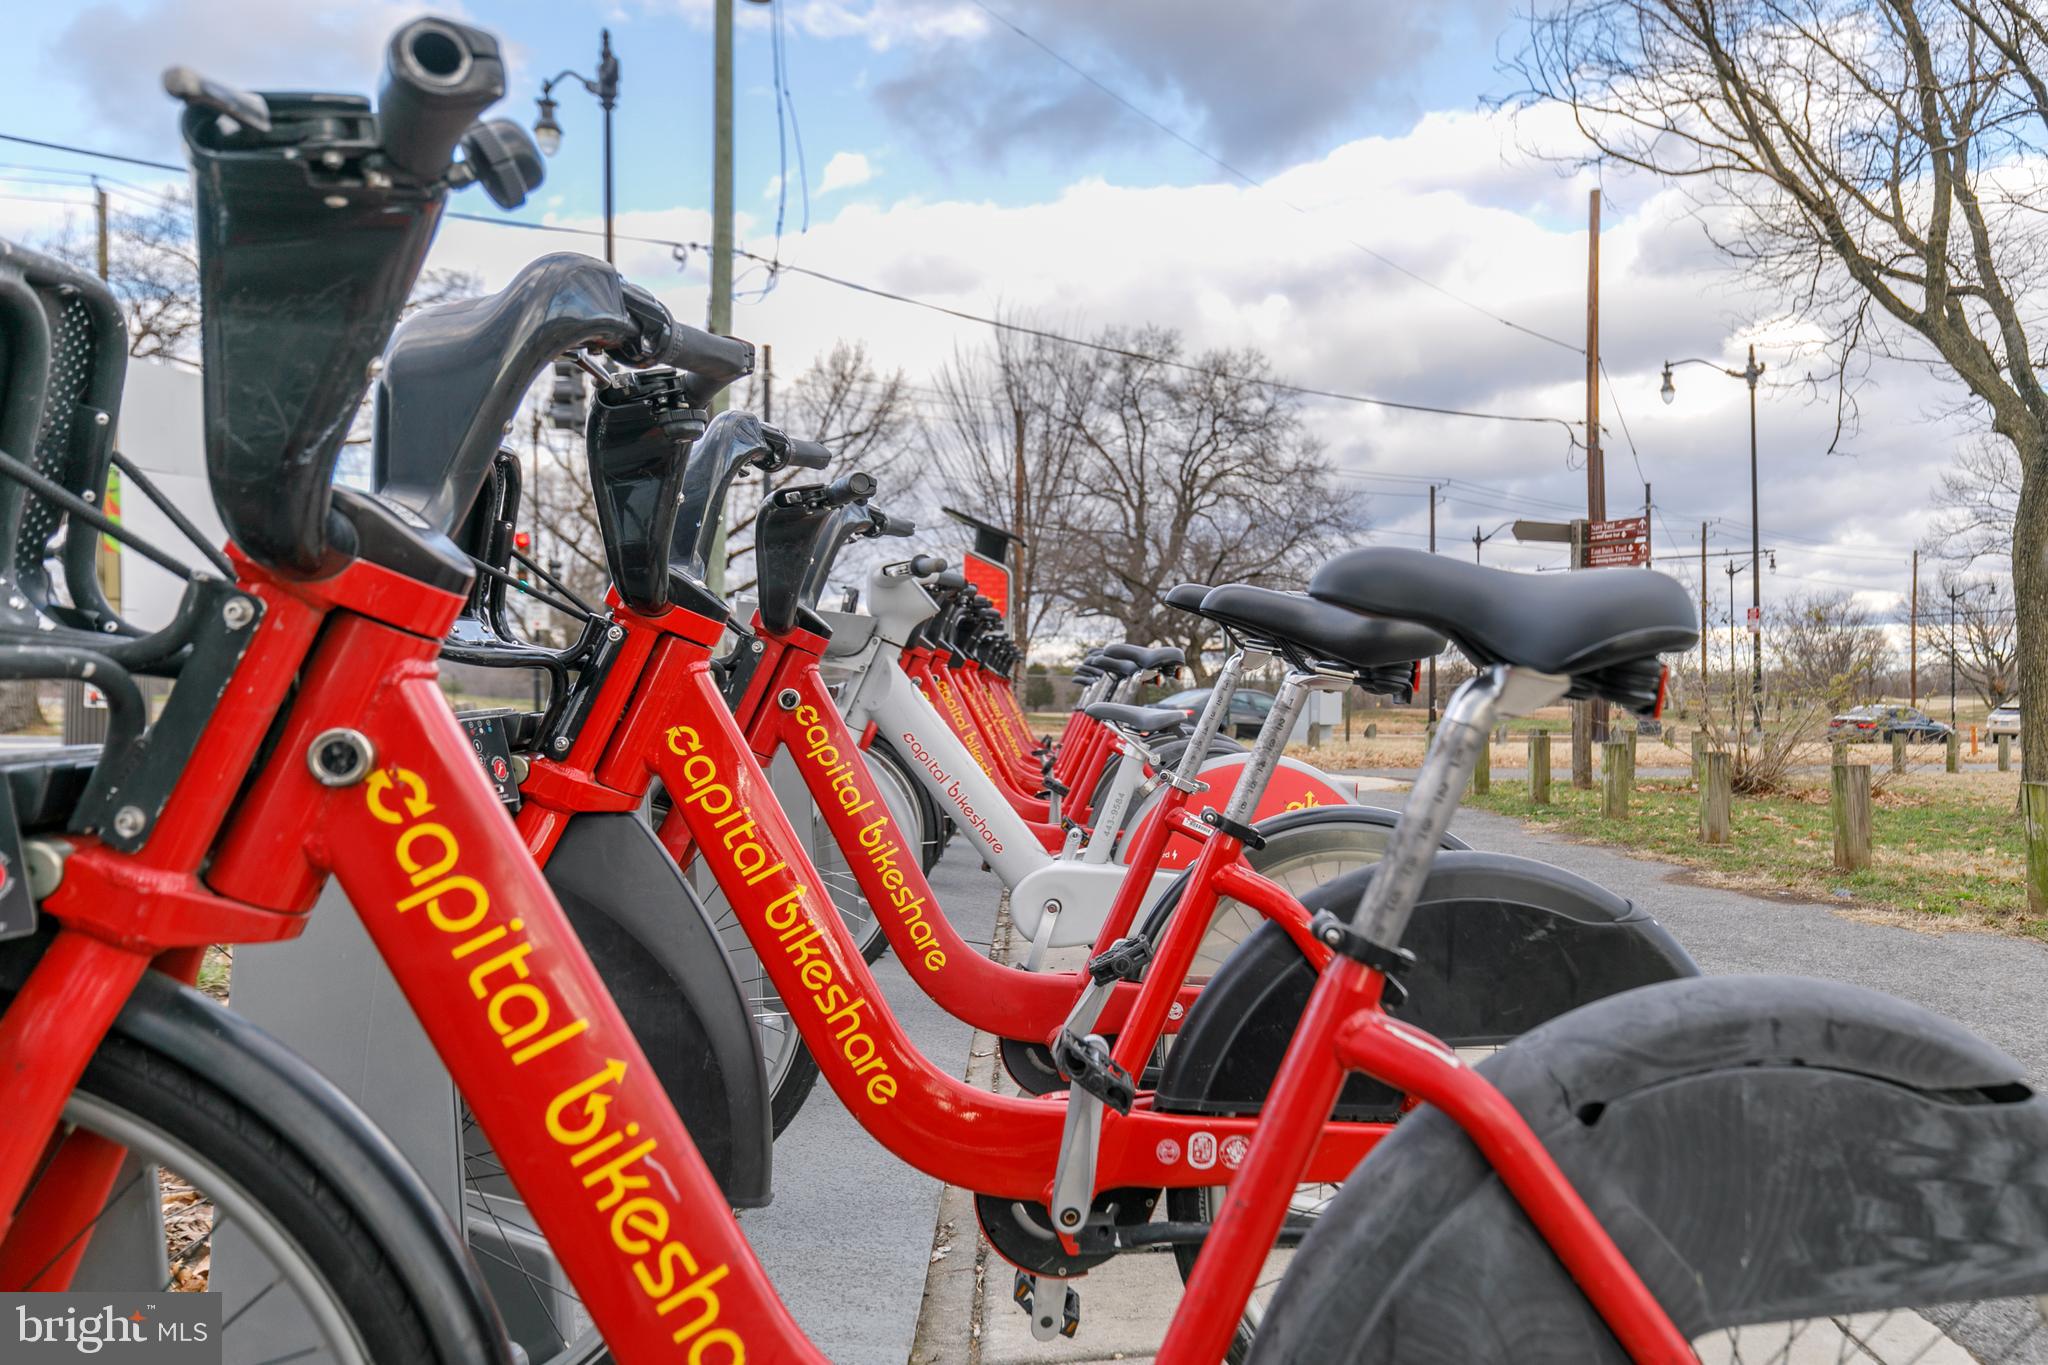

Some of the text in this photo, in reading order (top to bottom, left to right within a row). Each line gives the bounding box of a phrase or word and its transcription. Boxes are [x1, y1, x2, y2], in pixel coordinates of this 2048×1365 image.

[365, 767, 591, 1066] capital
[665, 724, 898, 1105] capital bikeshare
[795, 704, 946, 971] capital bikeshare
[903, 732, 952, 785] capital
[947, 780, 1004, 854] bikeshare
